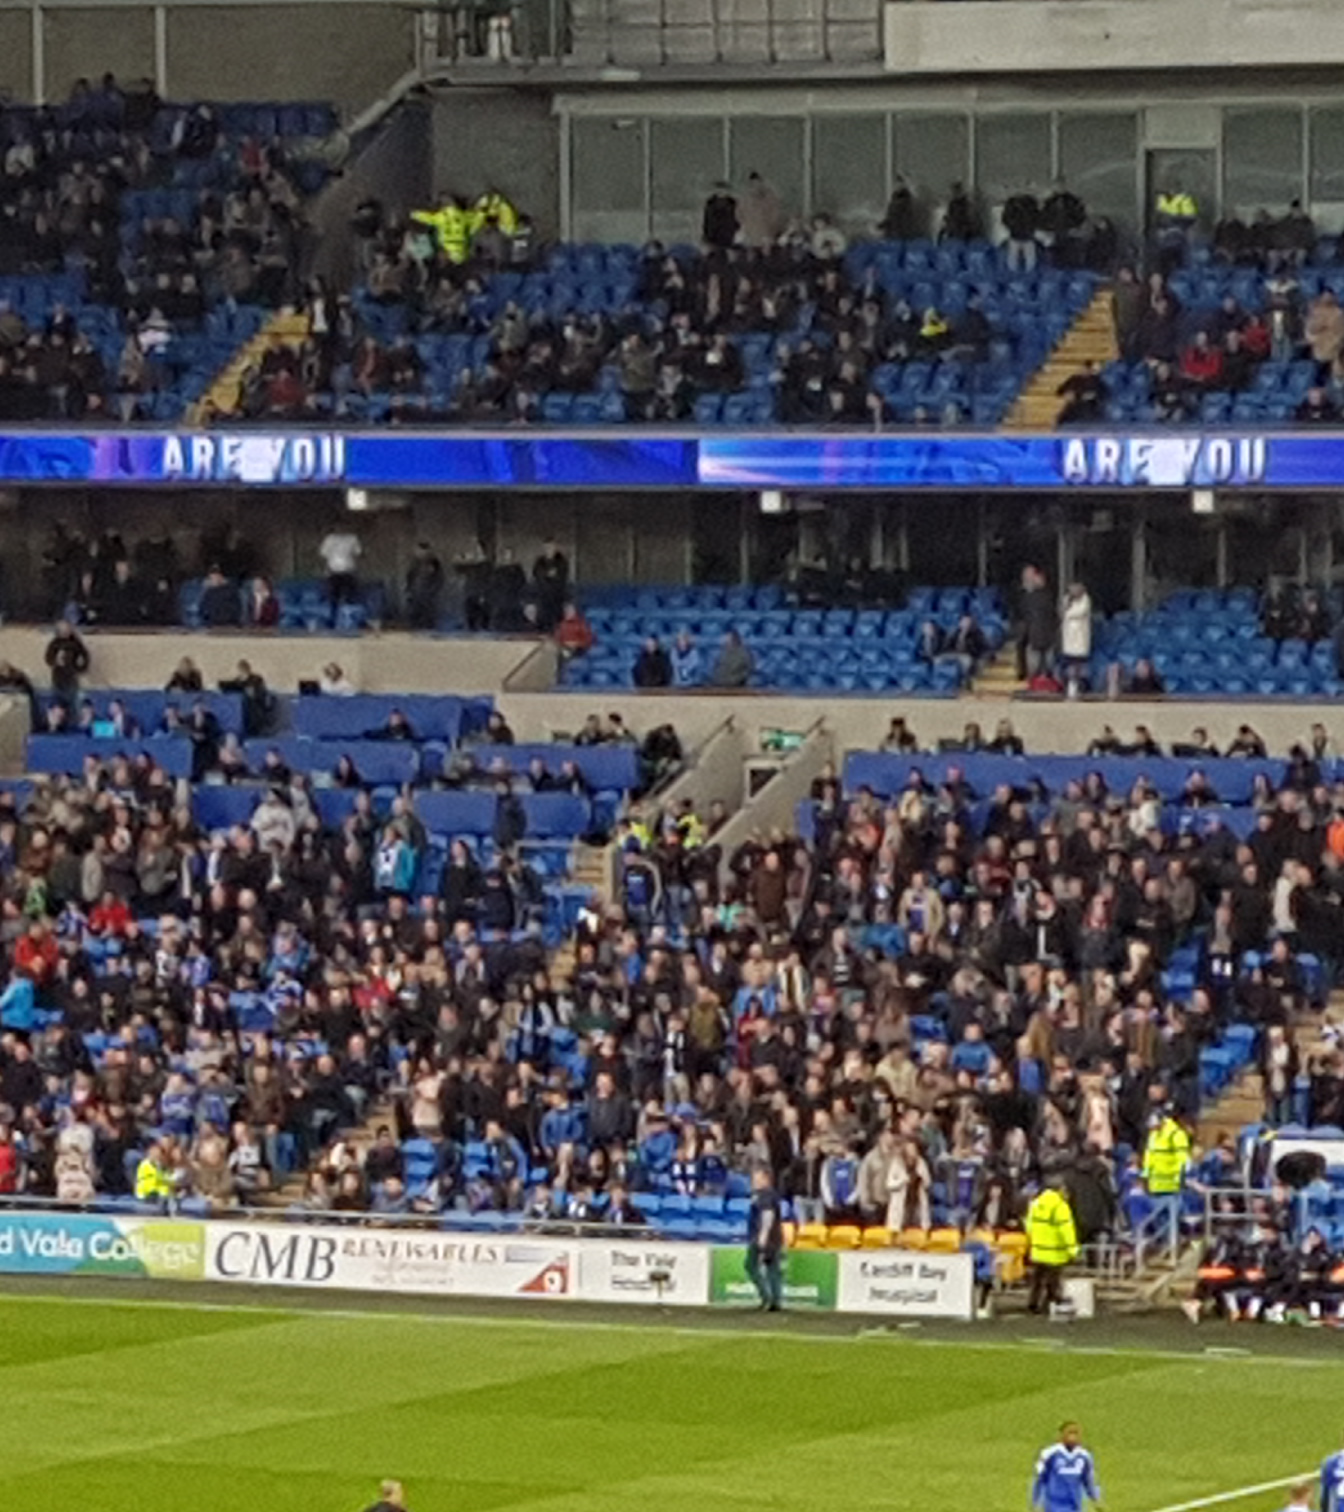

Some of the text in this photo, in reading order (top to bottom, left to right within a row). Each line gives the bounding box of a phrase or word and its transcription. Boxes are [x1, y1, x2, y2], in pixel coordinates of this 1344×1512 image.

[162, 437, 346, 478] ARE YOU
[1063, 438, 1265, 482] ARE YOU
[215, 1230, 337, 1281] CMB
